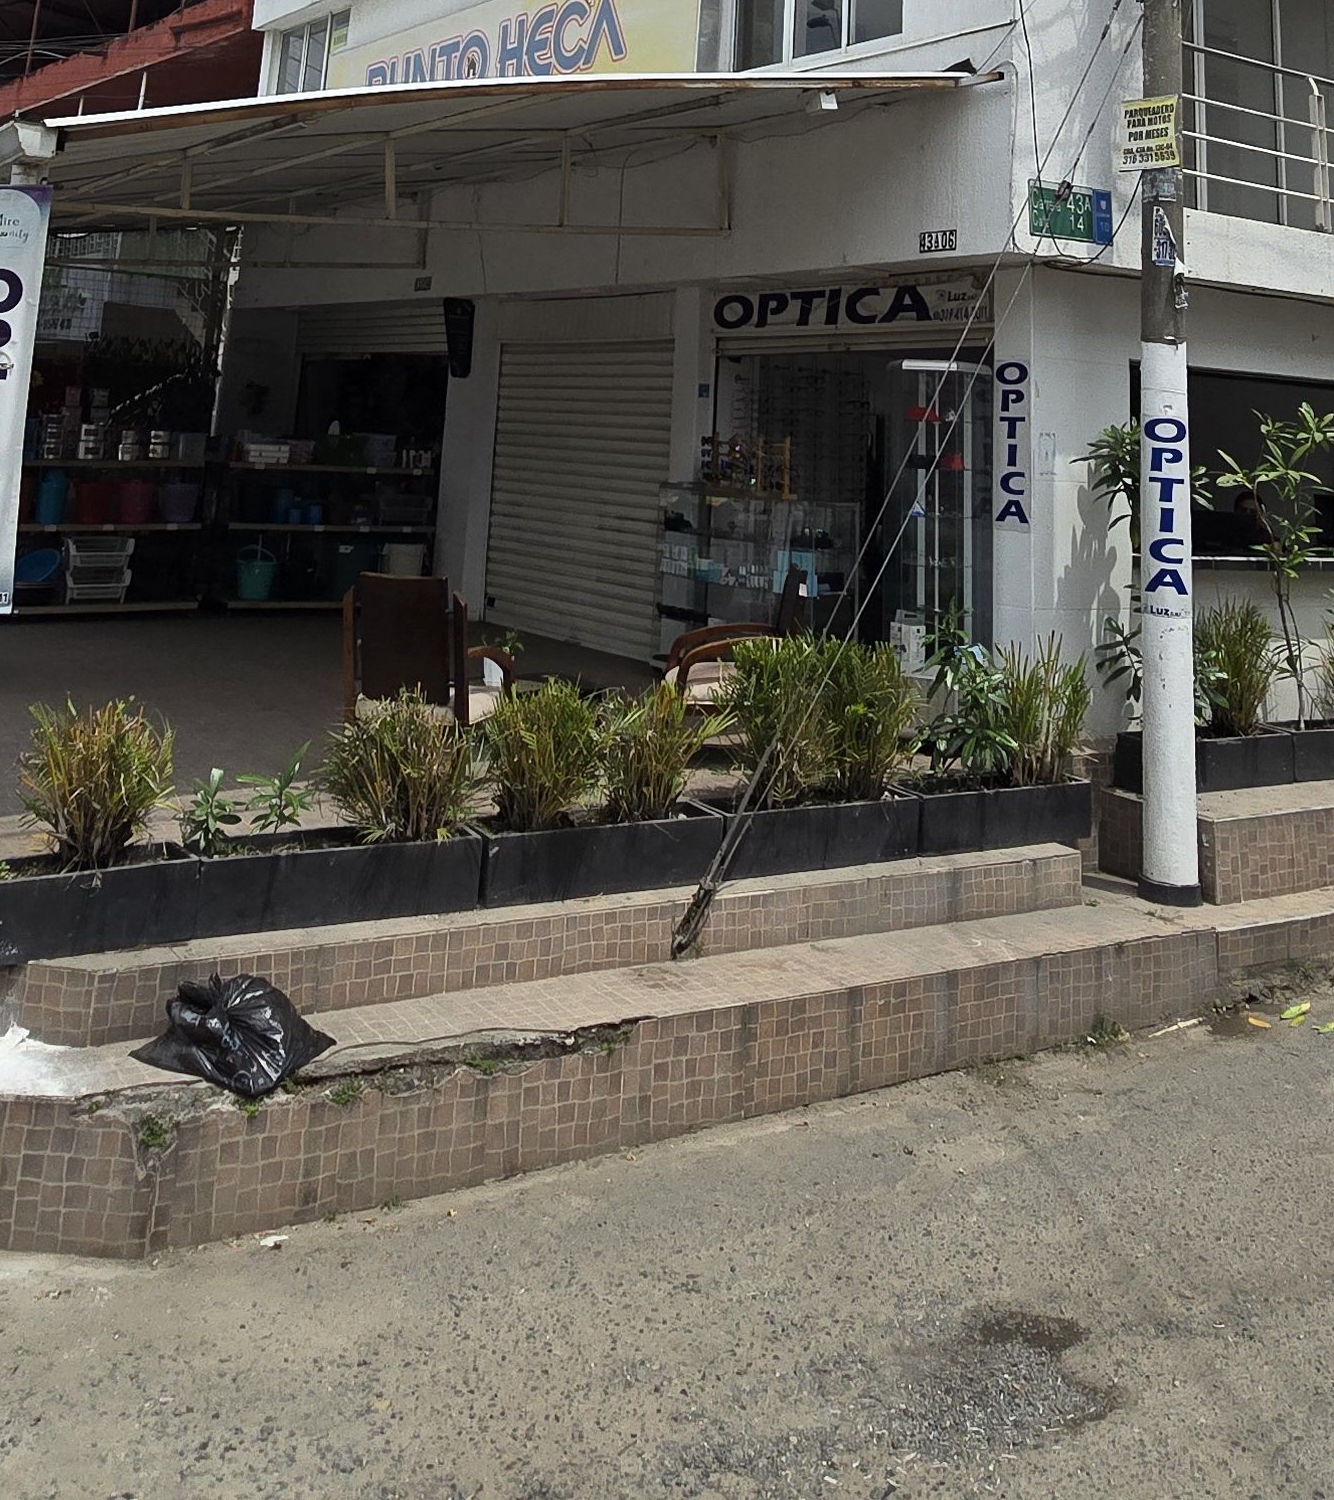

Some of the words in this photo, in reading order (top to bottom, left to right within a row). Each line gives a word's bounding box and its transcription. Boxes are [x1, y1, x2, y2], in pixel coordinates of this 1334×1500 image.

[1124, 103, 1174, 119] PARQUEADERO
[1127, 118, 1146, 129] PARA
[1148, 114, 1171, 126] MOTOS
[1128, 131, 1143, 142] POR
[1145, 127, 1169, 140] MESES
[1067, 193, 1092, 215] 43A
[1069, 214, 1085, 232] 14
[714, 284, 932, 330] OPTICA
[995, 362, 1029, 524] OPTICA
[1144, 418, 1188, 595] OPTICA
